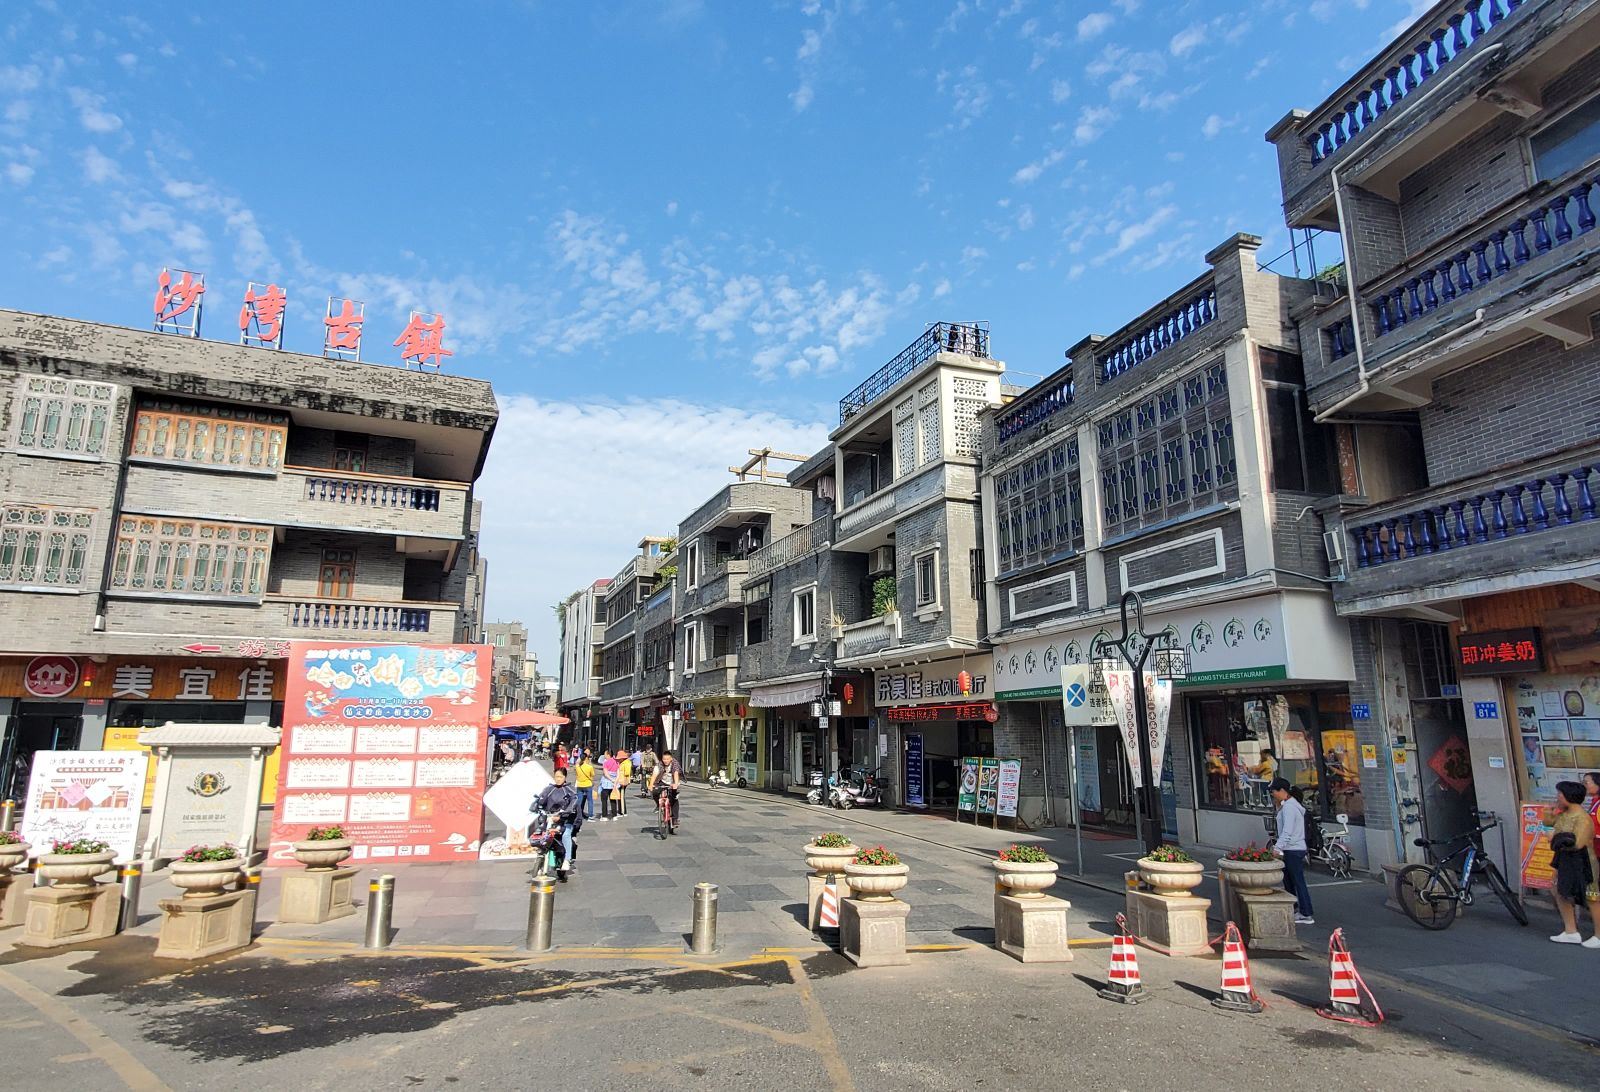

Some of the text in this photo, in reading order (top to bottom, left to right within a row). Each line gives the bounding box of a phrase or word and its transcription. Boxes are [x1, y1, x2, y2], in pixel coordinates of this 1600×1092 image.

[1461, 641, 1535, 664] 即冲姜奶
[112, 664, 274, 700] 美宜佳
[1230, 670, 1267, 679] RESTAURANT
